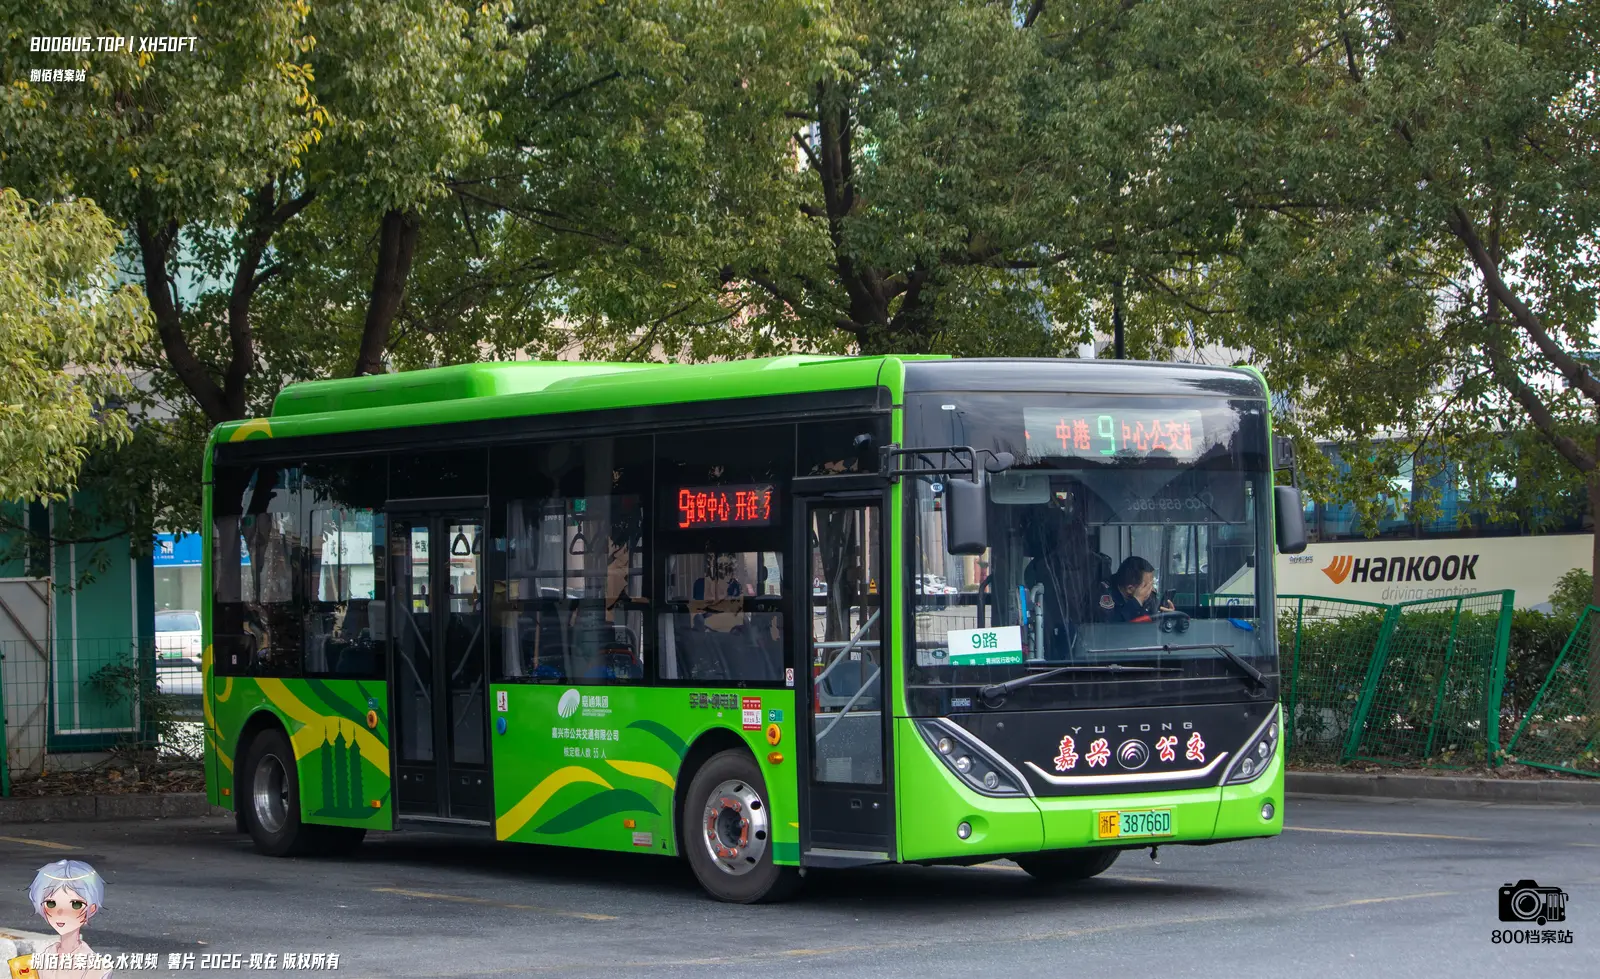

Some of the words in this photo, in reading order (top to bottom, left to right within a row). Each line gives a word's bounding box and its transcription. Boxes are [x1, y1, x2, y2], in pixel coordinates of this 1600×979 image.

[1056, 417, 1091, 450] 中港
[1097, 415, 1116, 455] 9
[678, 489, 690, 528] 9
[972, 632, 998, 649] 9路
[552, 726, 619, 742] 嘉兴市公共交通有限公司
[1071, 722, 1193, 734] YUTONG
[601, 748, 607, 759] 人
[1054, 735, 1110, 772] 嘉兴
[1156, 731, 1206, 763] 公交
[1100, 814, 1117, 834] 浙F
[1123, 812, 1170, 832] 38766D
